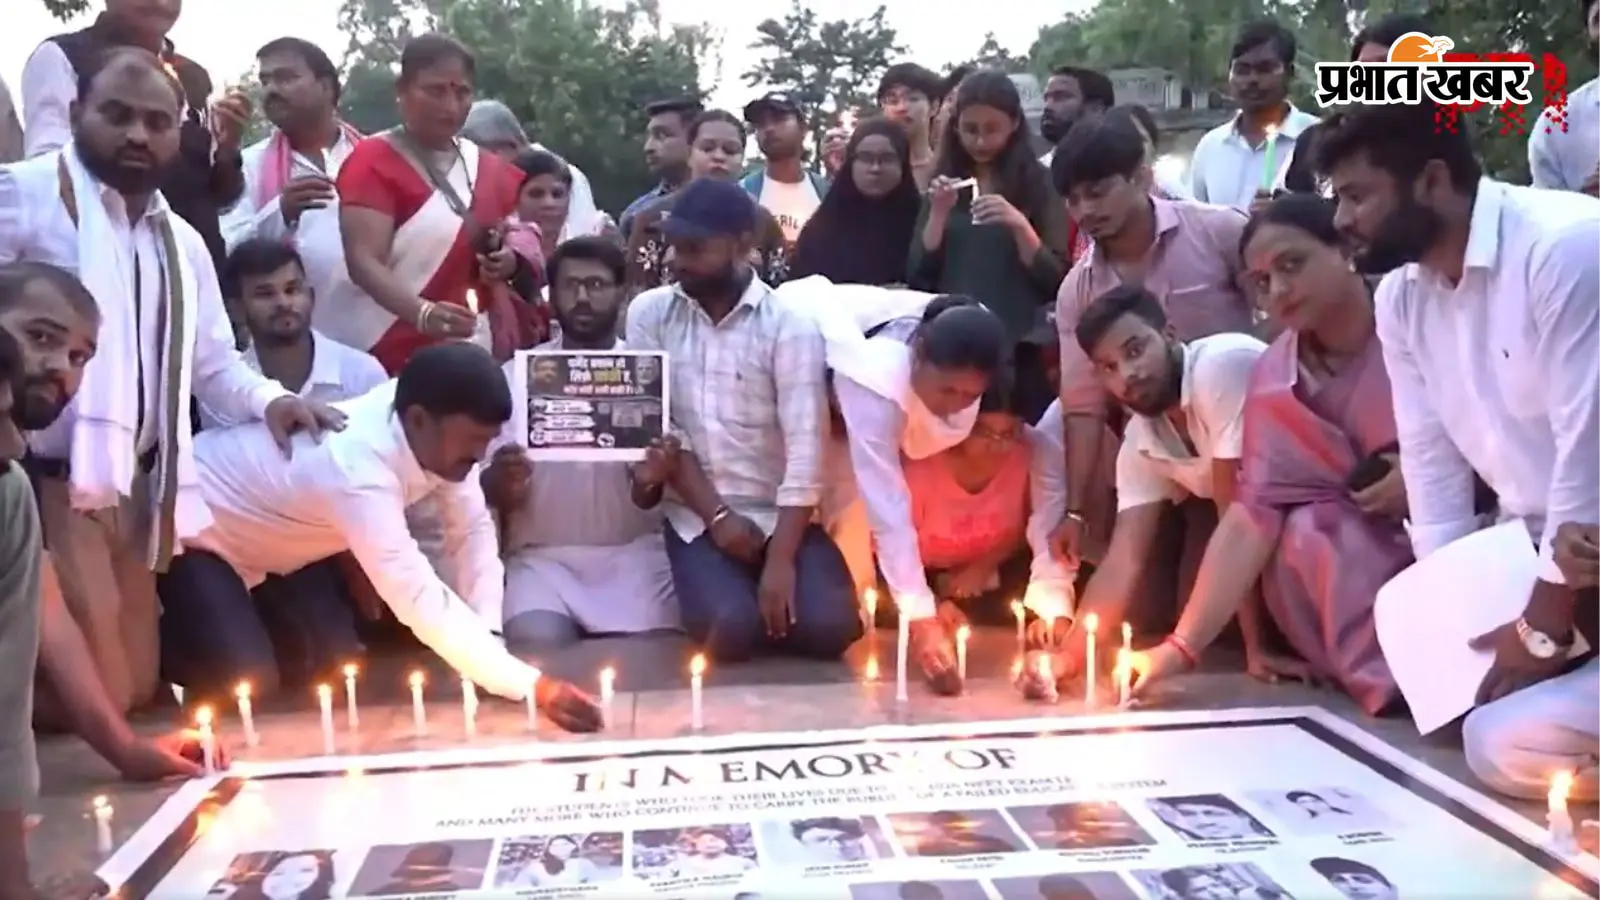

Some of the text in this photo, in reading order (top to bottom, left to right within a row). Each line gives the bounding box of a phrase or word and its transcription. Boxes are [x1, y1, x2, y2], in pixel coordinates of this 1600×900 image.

[659, 750, 921, 788] MEMOR
[943, 747, 1017, 770] OF
[589, 809, 632, 819] WHO
[635, 802, 720, 816] CONTINE
